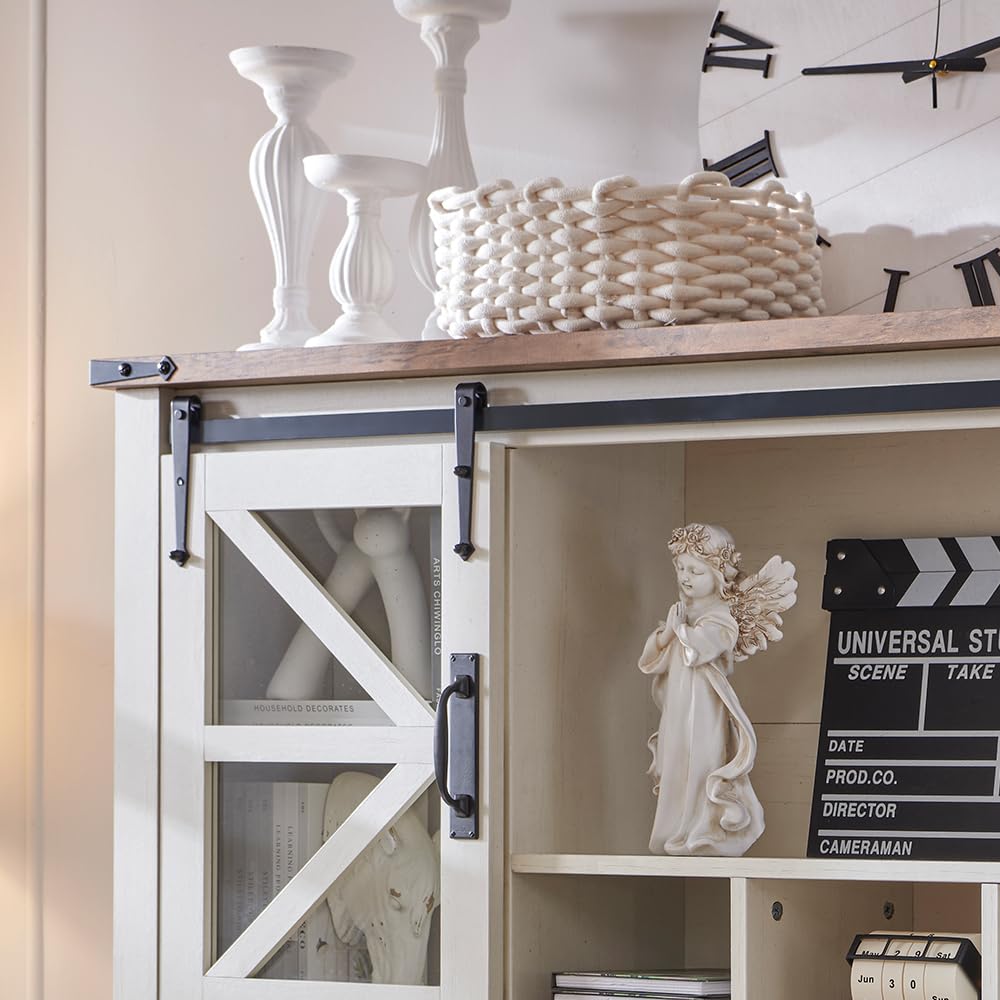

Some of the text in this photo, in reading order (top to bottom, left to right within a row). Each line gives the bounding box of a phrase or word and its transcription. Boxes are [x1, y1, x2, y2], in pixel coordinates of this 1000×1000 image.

[432, 557, 441, 587] ARTS
[837, 629, 959, 655] UNIVERSAL
[847, 664, 909, 681] SCENE
[947, 663, 996, 680] TAKE
[253, 704, 355, 713] HOUSEHOLD DECORATES
[828, 739, 865, 753] DATE
[825, 769, 898, 786] PROD.CO.
[822, 802, 898, 819] DIRECTOR
[819, 839, 913, 857] CAMERAMAN
[858, 975, 917, 989] Jun 3 0
